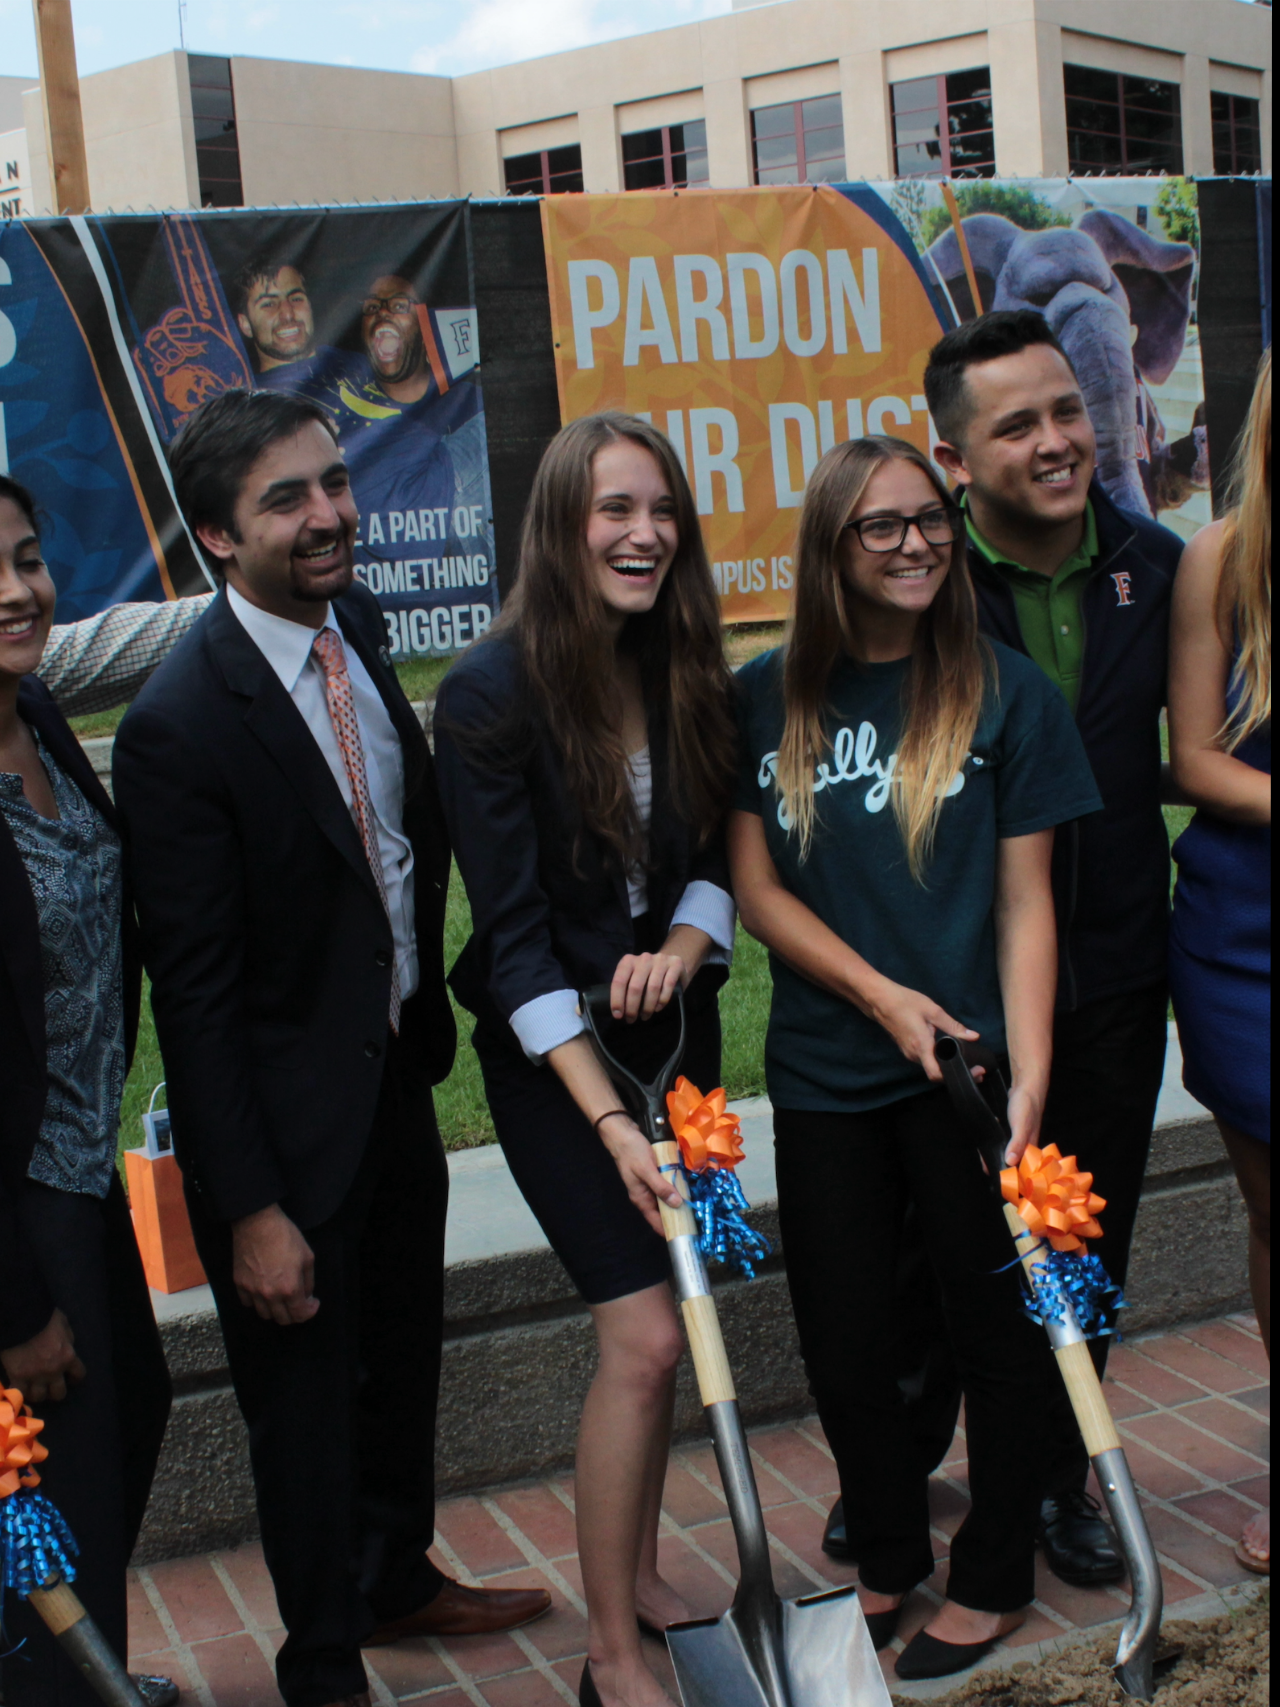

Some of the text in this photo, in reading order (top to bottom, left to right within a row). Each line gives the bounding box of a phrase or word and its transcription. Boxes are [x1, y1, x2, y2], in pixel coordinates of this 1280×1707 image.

[1, 198, 20, 218] NT
[567, 247, 882, 369] PARDON
[450, 318, 470, 356] F
[368, 512, 385, 545] A
[388, 508, 448, 543] PART
[454, 505, 483, 538] OF
[771, 556, 794, 590] IS
[1110, 572, 1132, 607] F
